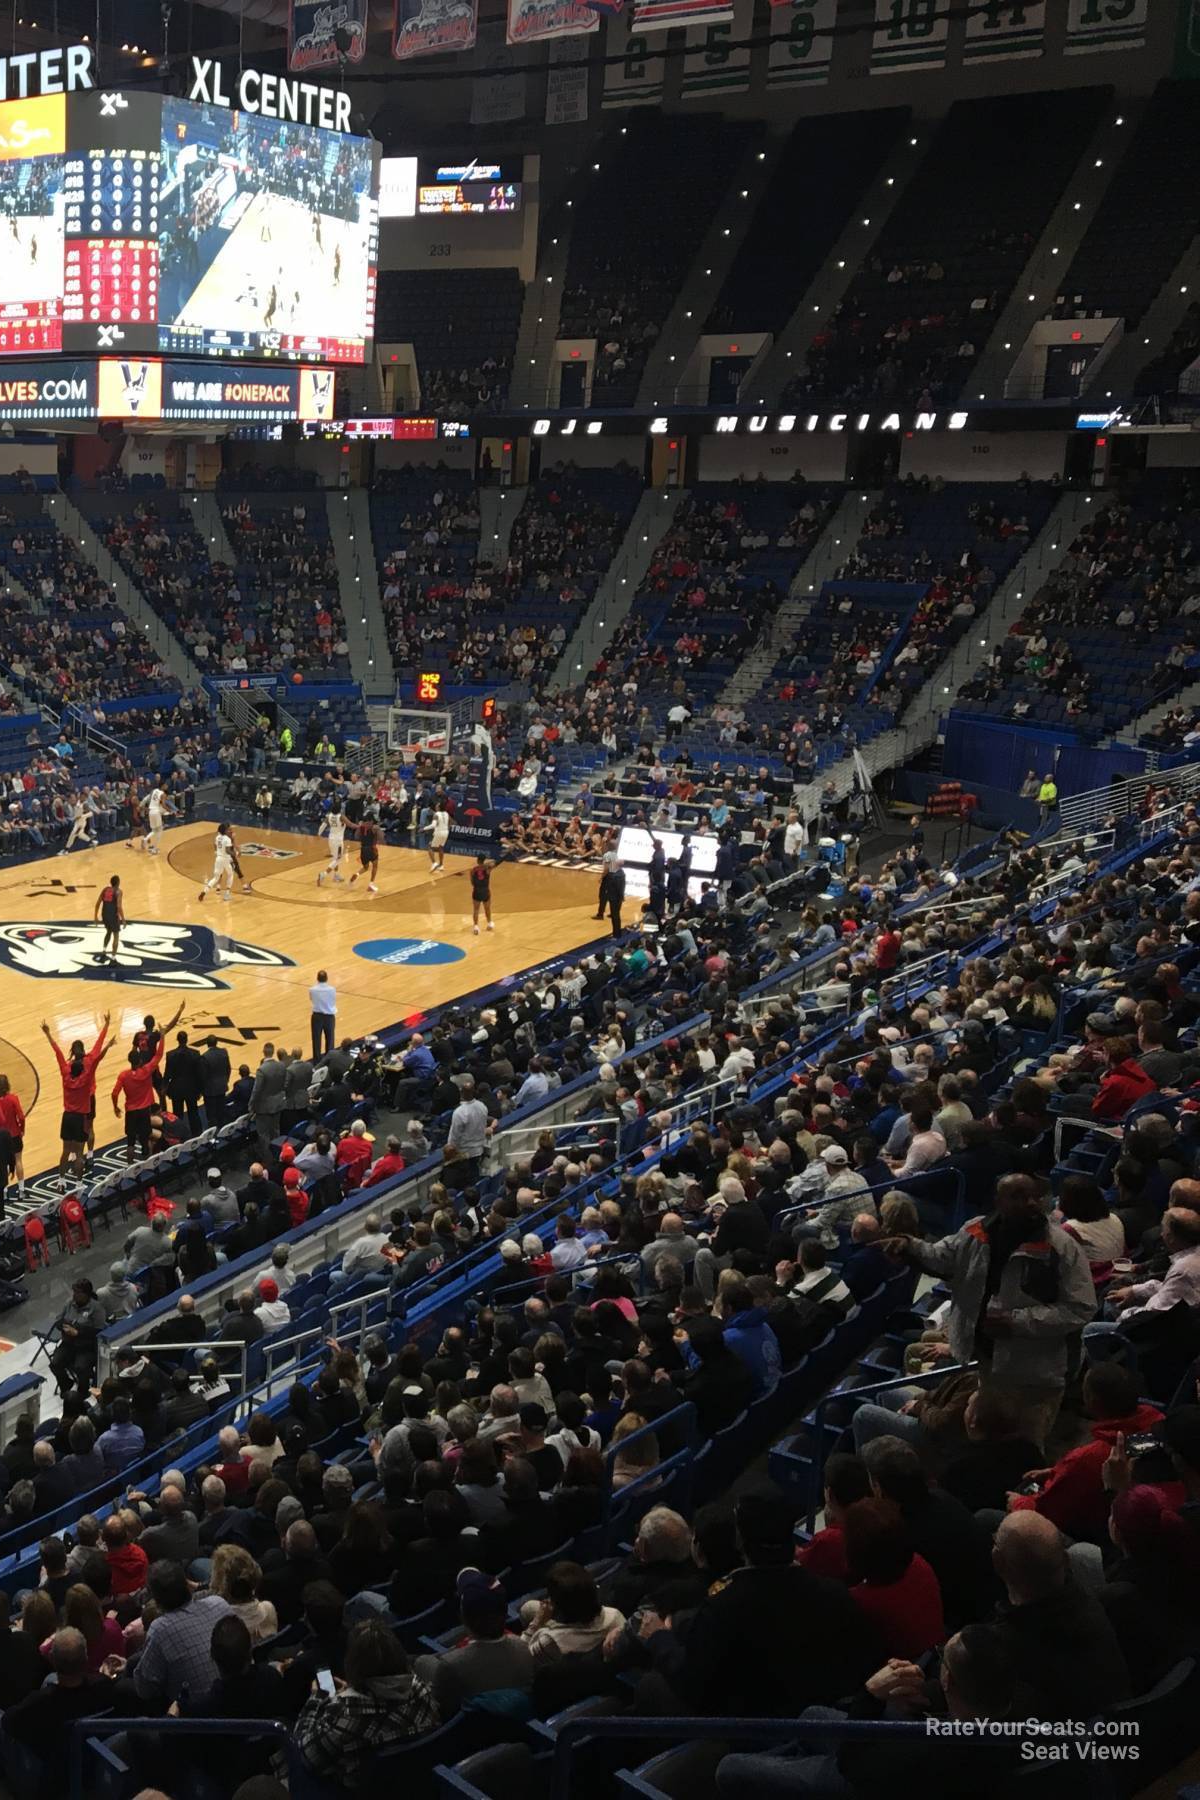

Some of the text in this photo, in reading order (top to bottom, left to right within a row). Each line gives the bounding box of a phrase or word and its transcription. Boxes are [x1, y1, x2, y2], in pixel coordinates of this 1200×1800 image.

[190, 56, 351, 133] XL CENTER
[100, 93, 128, 116] XL
[430, 244, 451, 256] 233
[97, 325, 125, 347] XL
[173, 382, 194, 402] WE
[224, 383, 290, 403] #ONEPACK
[320, 422, 344, 432] 14:52
[651, 418, 668, 433] &
[716, 413, 968, 432] MUSICIANS
[138, 453, 153, 461] 107
[421, 682, 438, 699] 26
[451, 824, 492, 837] TRAVELERS
